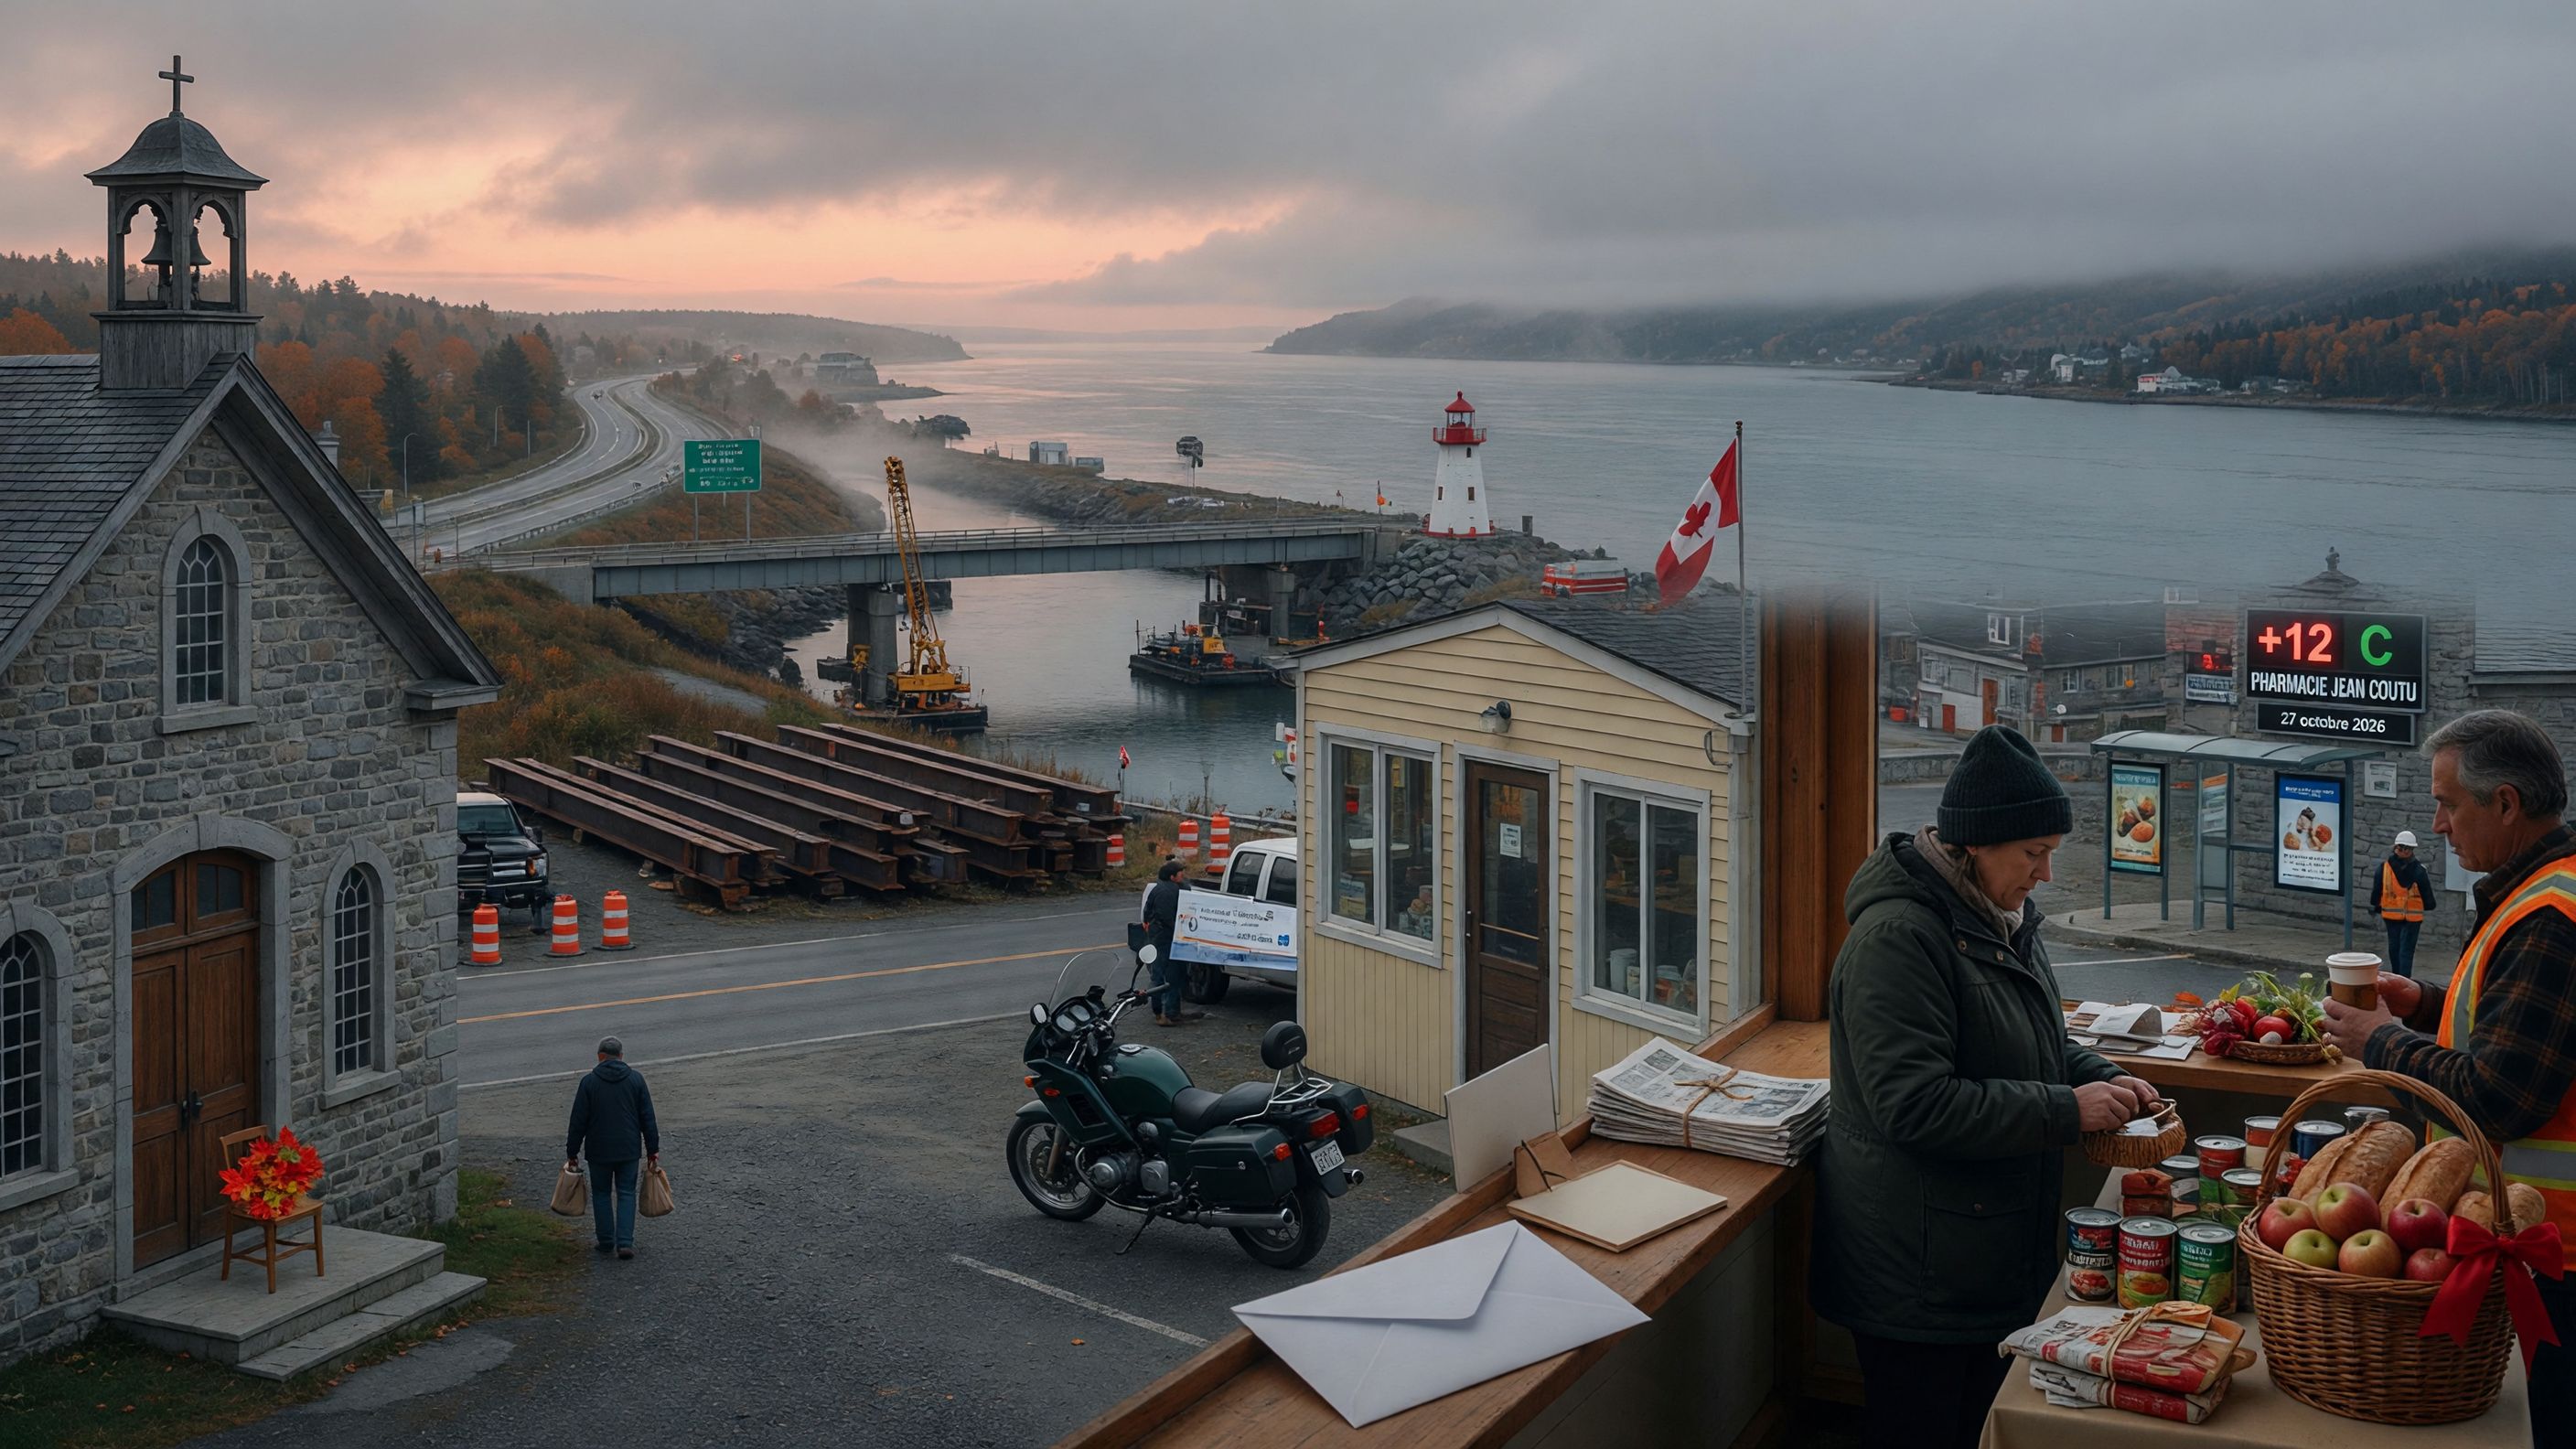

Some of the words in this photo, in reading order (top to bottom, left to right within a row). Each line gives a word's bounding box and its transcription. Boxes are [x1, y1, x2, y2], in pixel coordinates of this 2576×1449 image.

[2258, 622, 2333, 662] +12
[2360, 624, 2393, 666] C
[2250, 671, 2328, 697] PHARMACIE
[2331, 676, 2366, 699] JEAN
[2369, 679, 2417, 702] COUTU
[2281, 712, 2297, 725] 27
[2300, 715, 2349, 730] octobre
[2352, 717, 2386, 733] 2026
